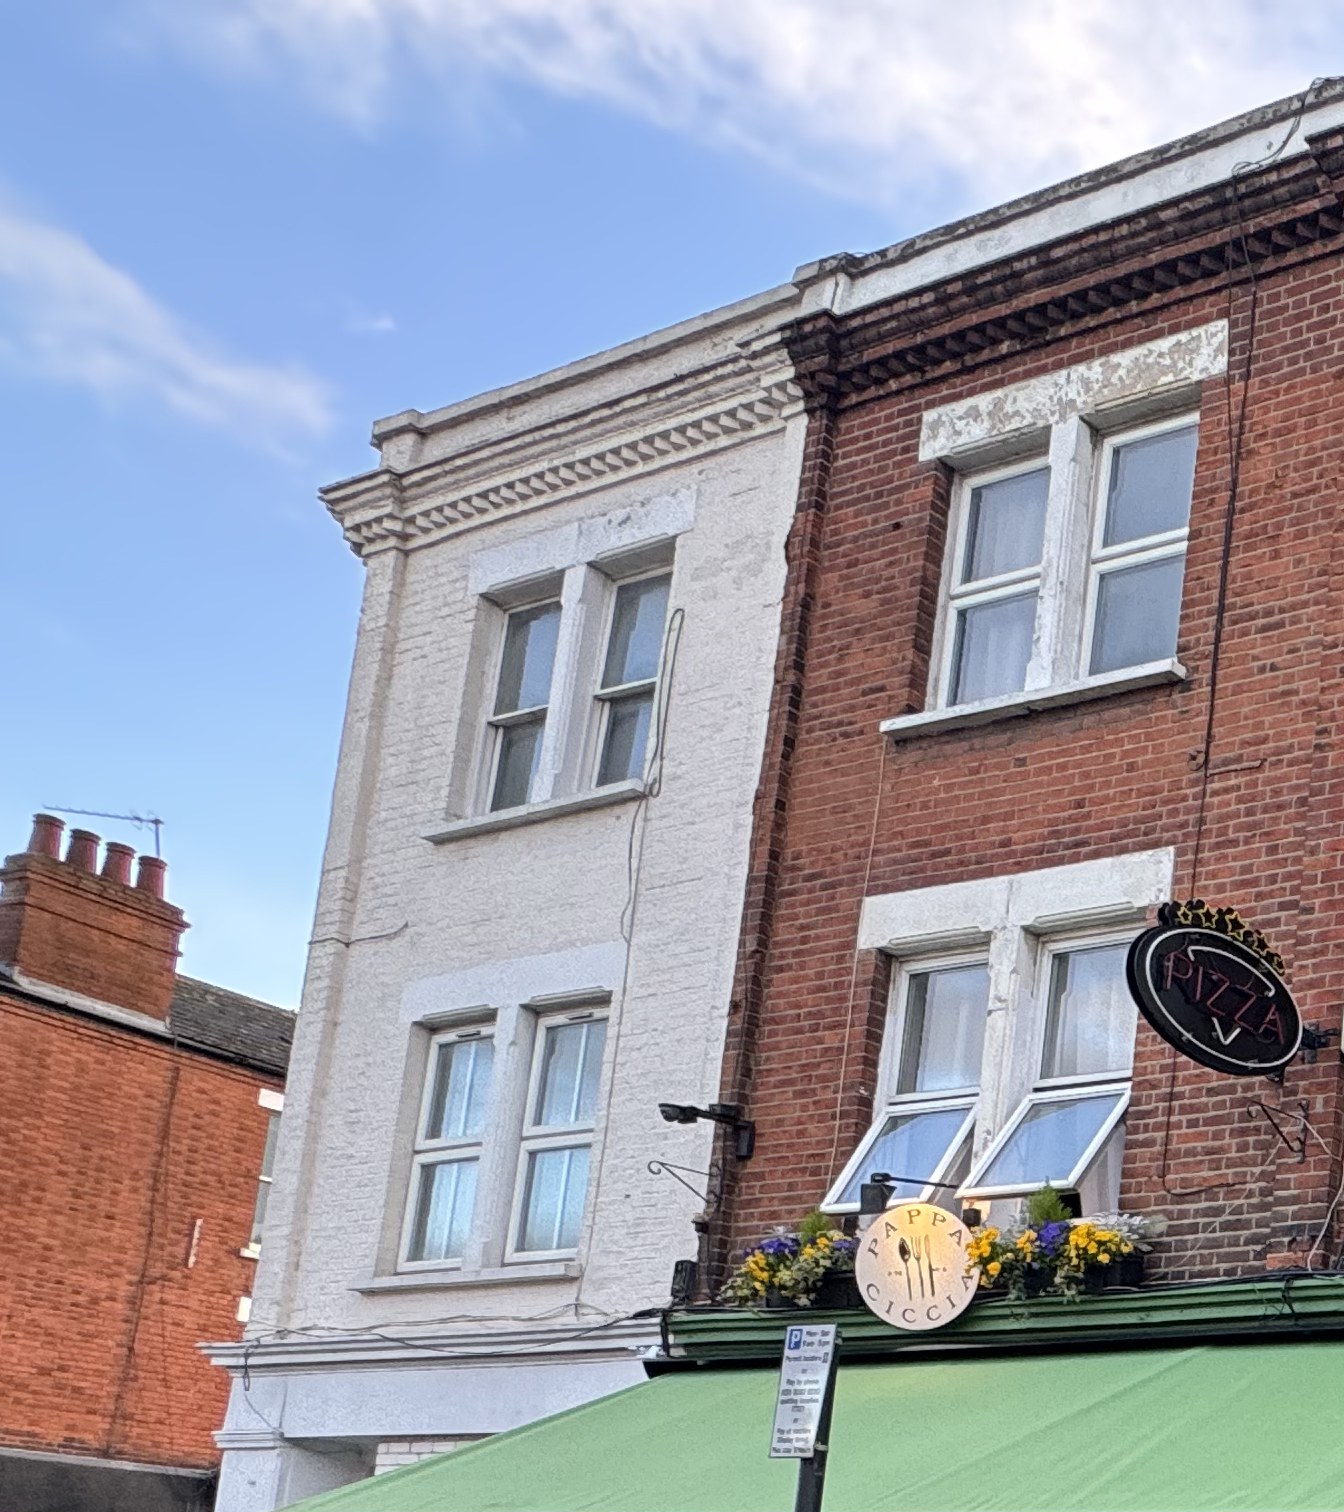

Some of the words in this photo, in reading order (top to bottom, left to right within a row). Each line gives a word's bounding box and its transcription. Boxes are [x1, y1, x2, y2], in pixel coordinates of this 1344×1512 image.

[1163, 951, 1286, 1044] PIZZA
[867, 1208, 963, 1258] PAPPA
[866, 1274, 974, 1323] CICCIA
